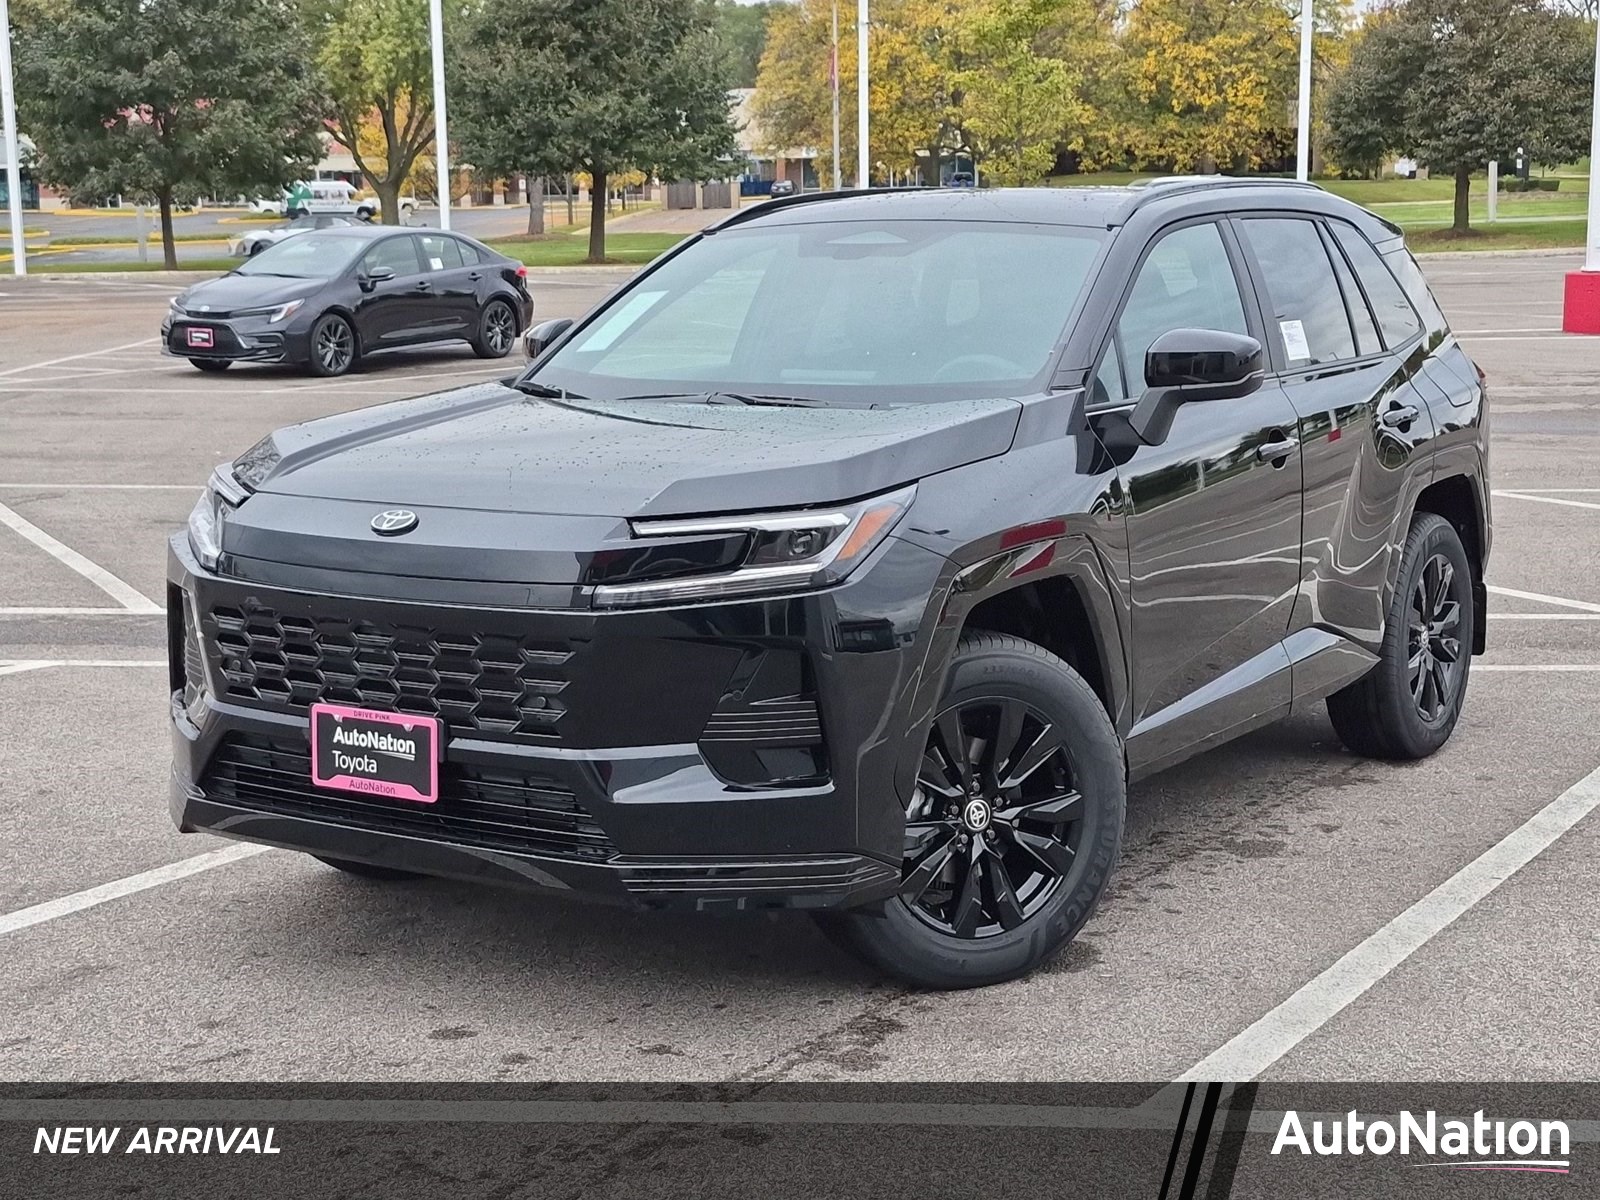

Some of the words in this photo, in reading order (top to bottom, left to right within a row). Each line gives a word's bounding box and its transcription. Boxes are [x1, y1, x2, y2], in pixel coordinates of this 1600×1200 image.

[353, 710, 372, 719] DRIVE
[375, 713, 391, 721] PINK
[333, 726, 416, 754] AutoNation
[332, 750, 377, 773] Toyota
[349, 780, 396, 794] AutoNation
